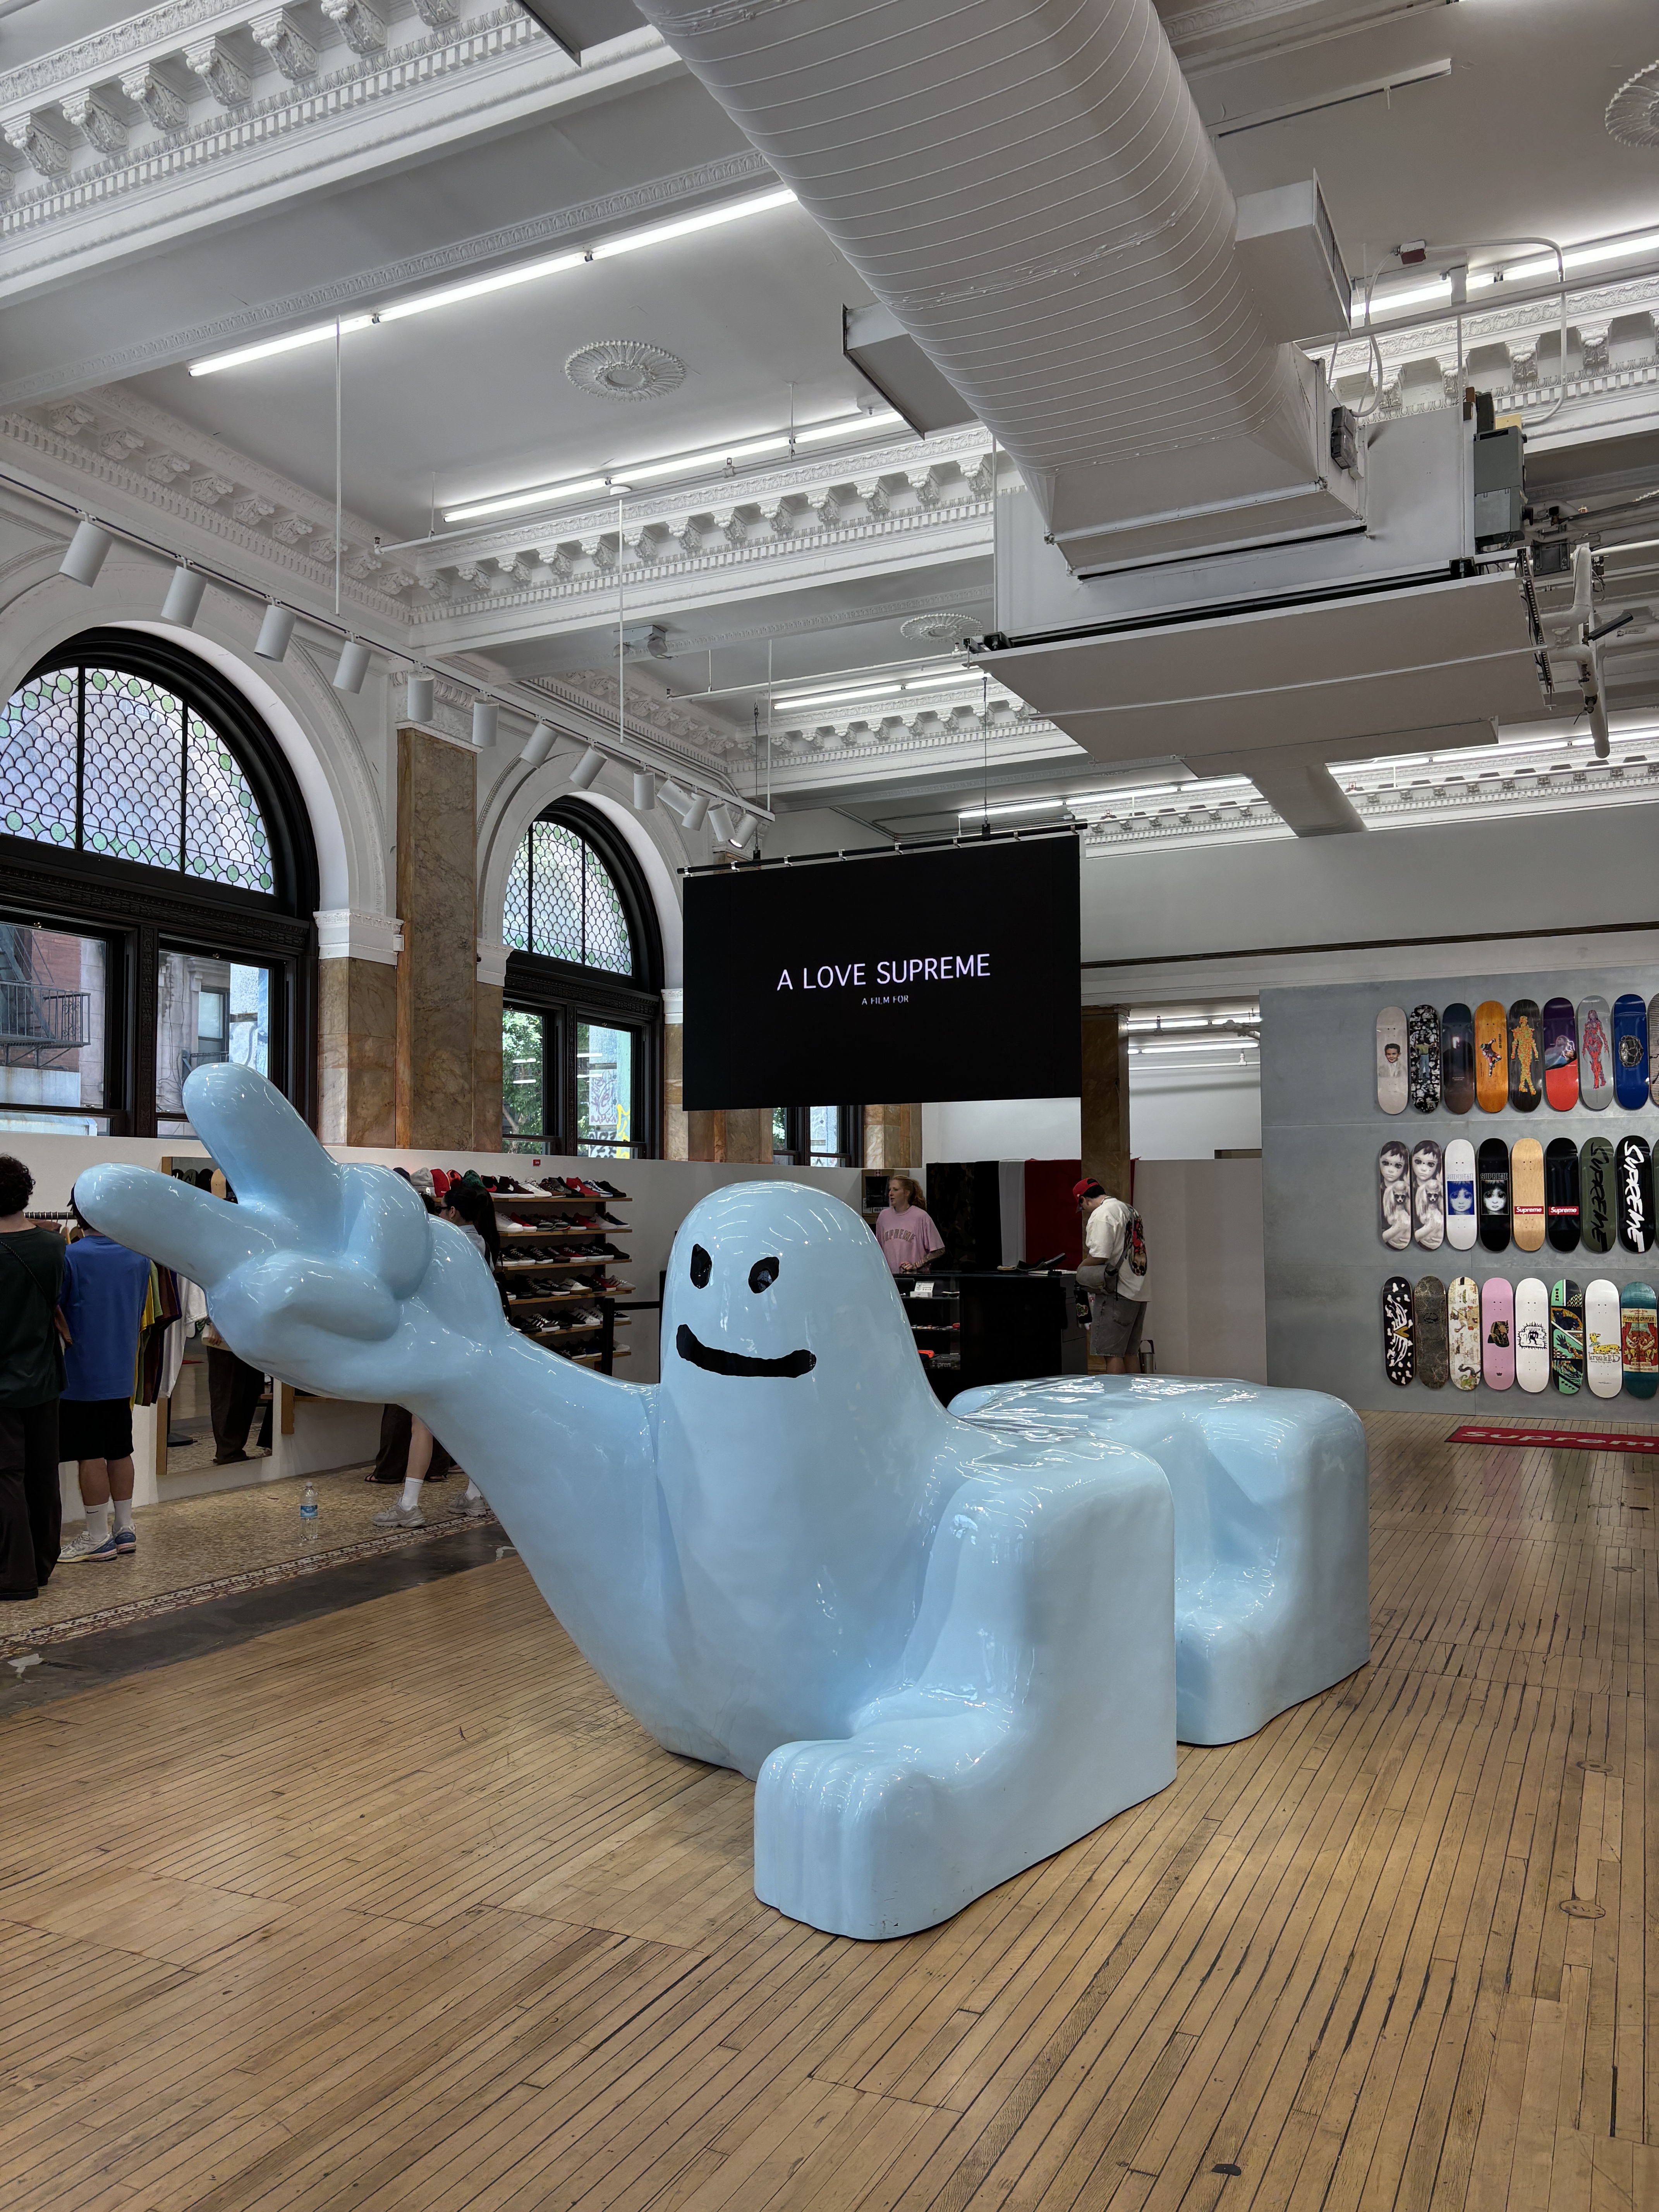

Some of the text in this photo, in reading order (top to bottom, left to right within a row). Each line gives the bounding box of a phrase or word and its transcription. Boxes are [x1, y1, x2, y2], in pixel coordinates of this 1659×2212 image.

[777, 954, 990, 991] A LOVE SUPREME
[883, 1229, 916, 1243] UPREME
[1462, 1432, 1659, 1447] Suprem
